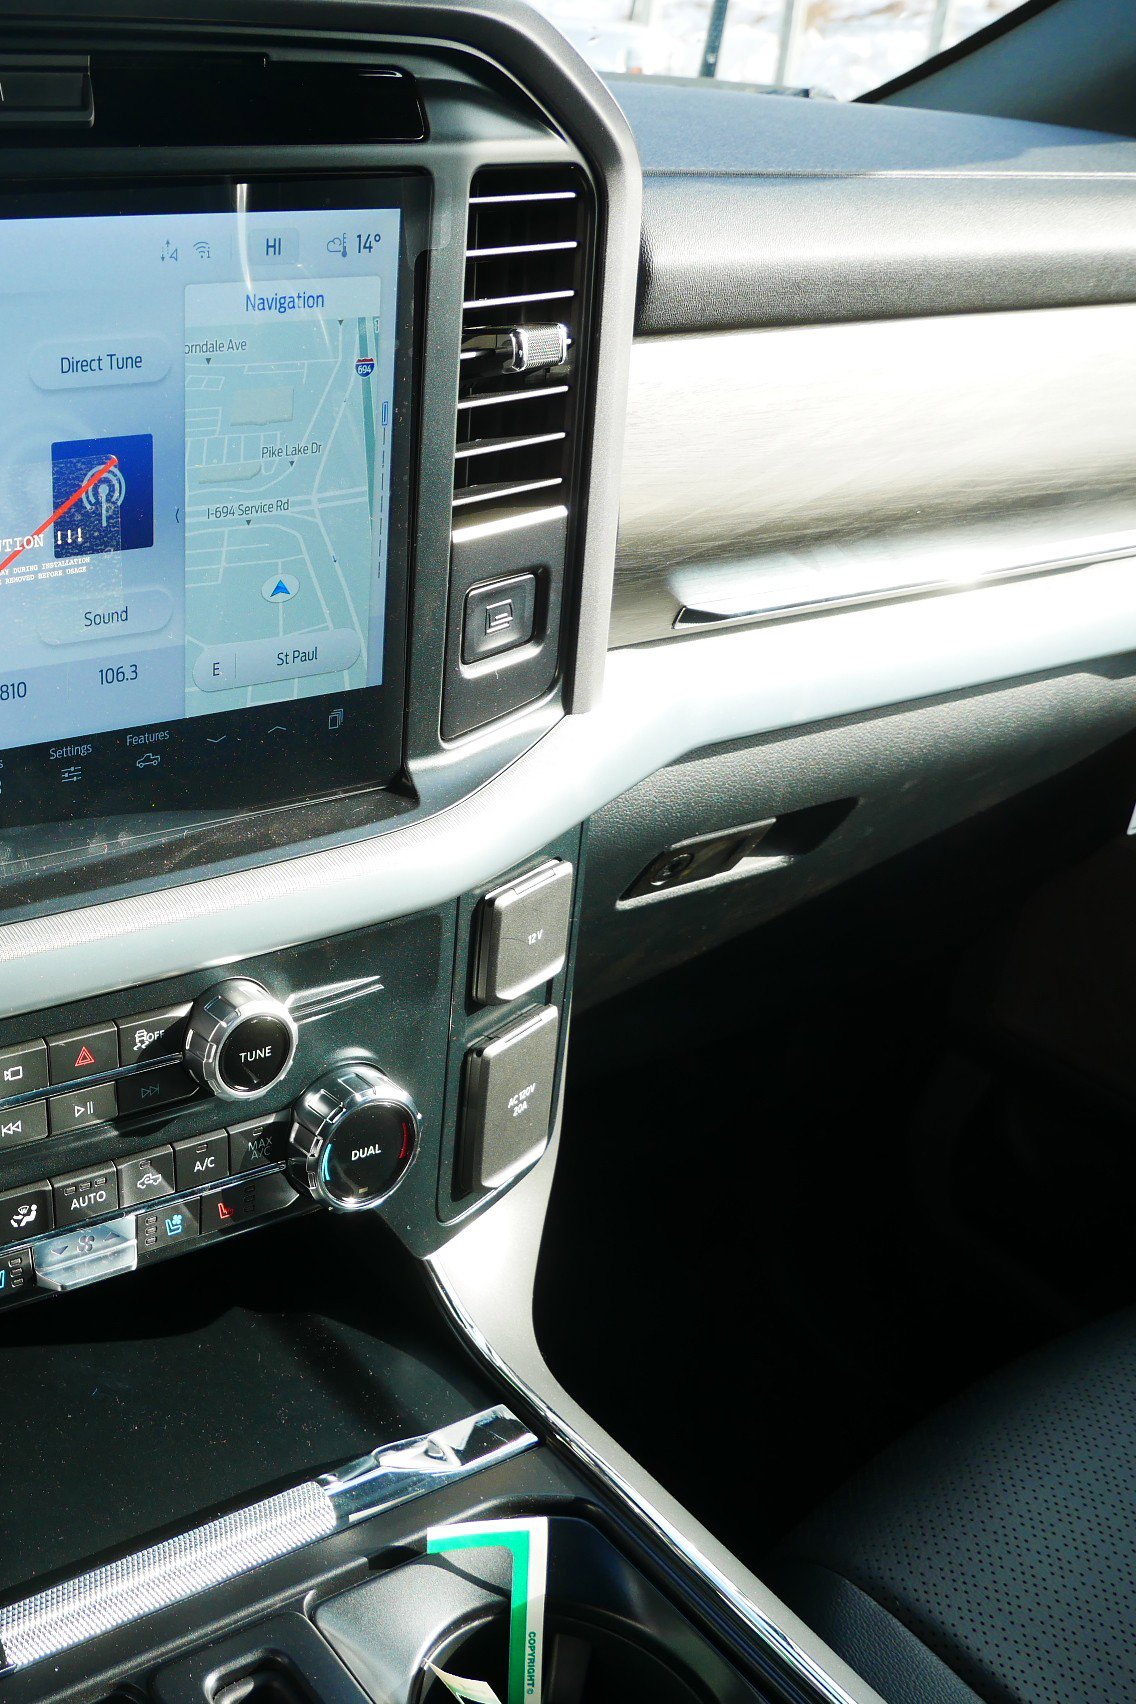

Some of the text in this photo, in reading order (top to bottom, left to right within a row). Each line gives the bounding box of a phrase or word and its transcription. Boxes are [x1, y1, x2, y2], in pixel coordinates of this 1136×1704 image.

[265, 237, 282, 256] HI
[245, 292, 325, 313] Navigation
[227, 338, 247, 351] Ave
[60, 353, 143, 374] Direct Tune
[357, 364, 372, 375] 694
[261, 442, 322, 458] Pike Lake Dr
[207, 499, 289, 518] I-694 Service Rd
[13, 564, 38, 574] DURING
[41, 557, 91, 571] INSTALLATION
[5, 574, 35, 585] REMOVED
[38, 570, 63, 580] BEFORE
[66, 566, 87, 575] USAGE
[84, 606, 129, 627] Sound
[276, 647, 319, 666] St Paul
[98, 664, 139, 686] 106.3
[212, 663, 221, 676] E
[0, 682, 28, 701] 810
[126, 729, 170, 747] Features
[49, 741, 93, 760] Settings
[146, 1030, 164, 1042] OFF
[239, 1046, 272, 1063] TUNE
[508, 1083, 536, 1109] AC 120V
[513, 1101, 527, 1117] 20A
[248, 1137, 273, 1151] MAX
[351, 1144, 382, 1161] DUAL
[194, 1156, 215, 1172] A/C
[70, 1191, 106, 1211] AUTO
[527, 1632, 536, 1688] COPYRIGHT
